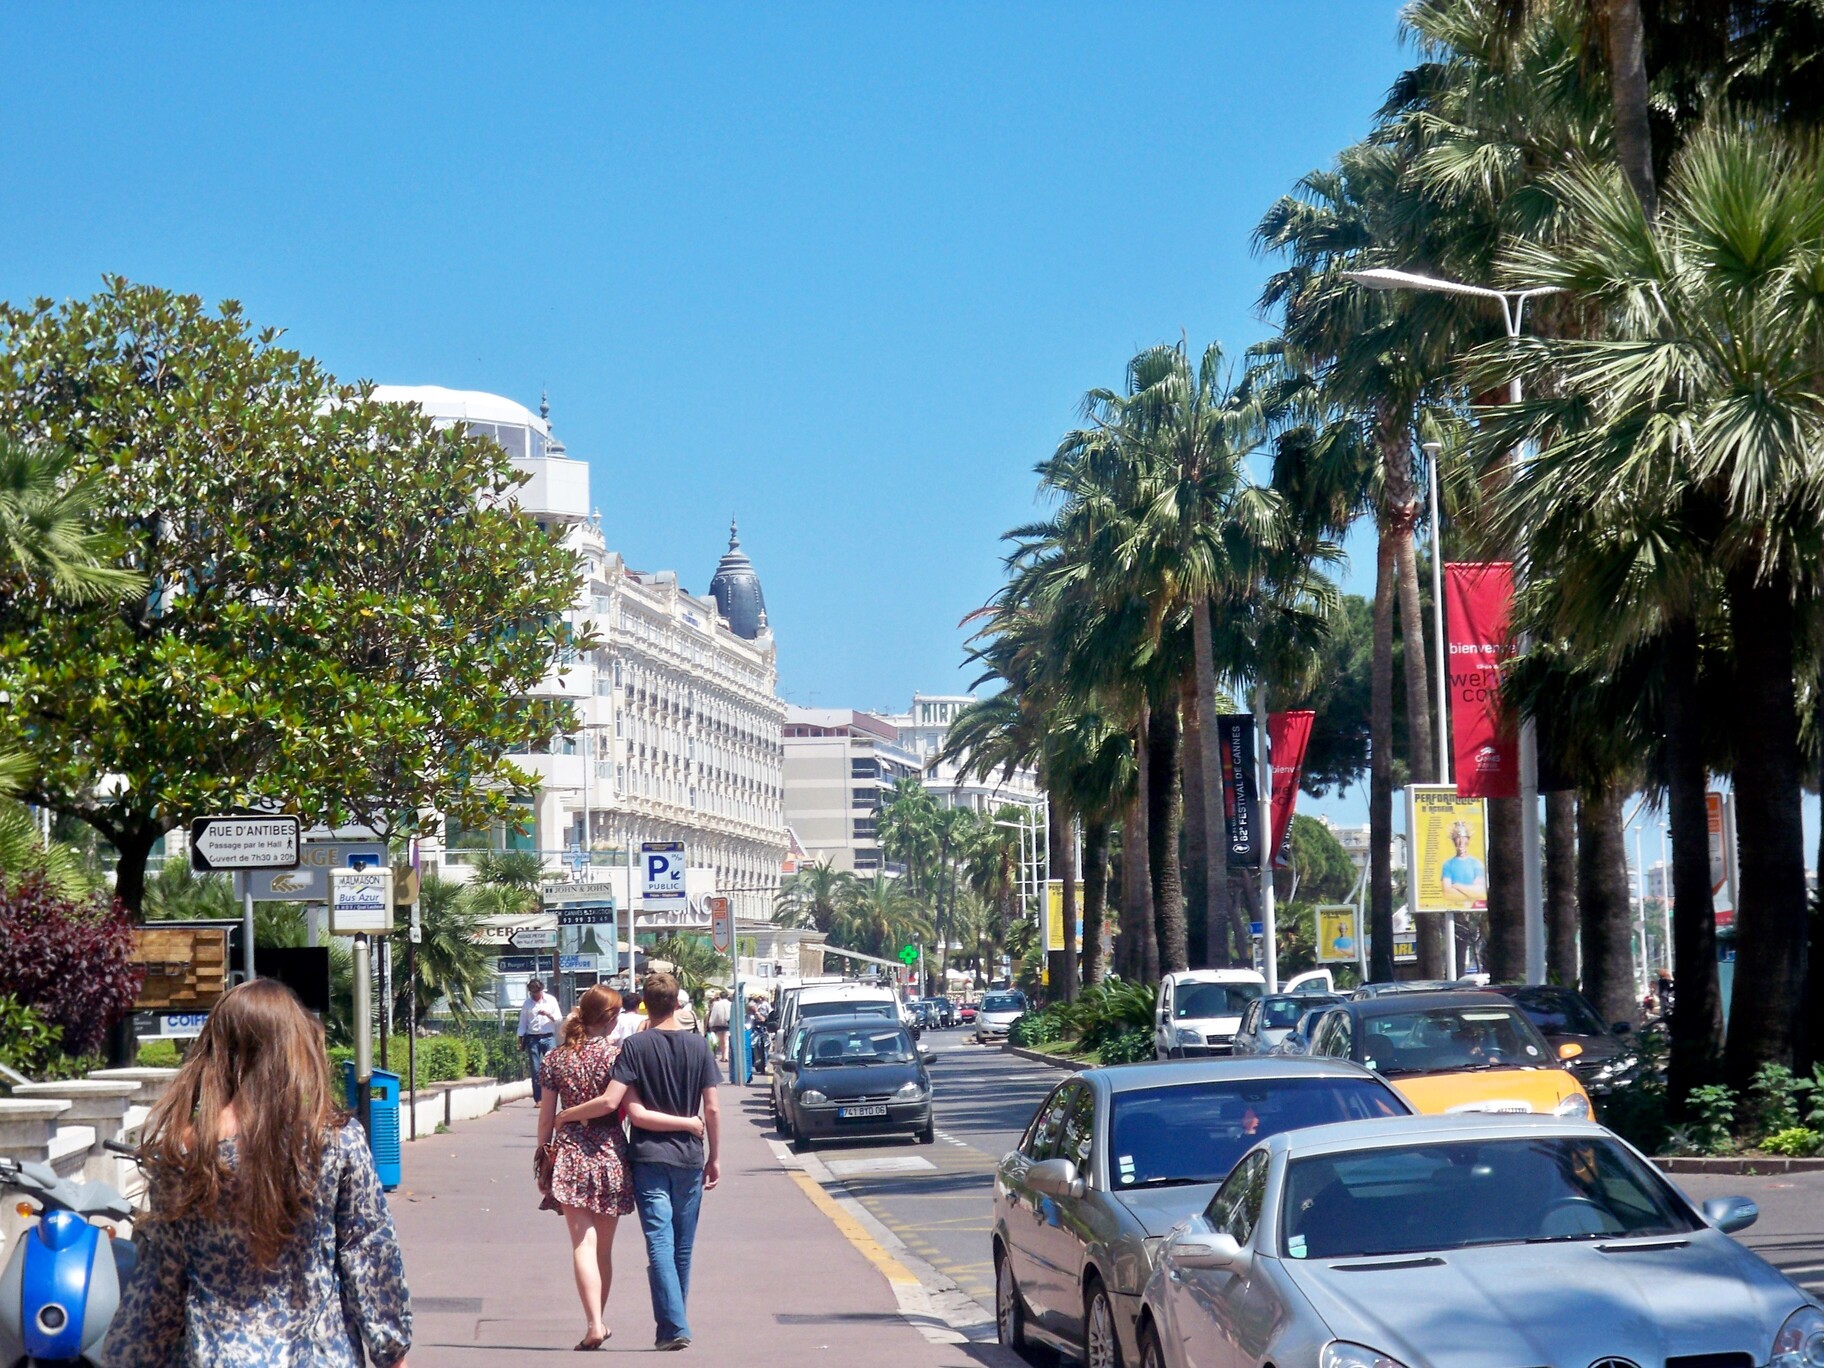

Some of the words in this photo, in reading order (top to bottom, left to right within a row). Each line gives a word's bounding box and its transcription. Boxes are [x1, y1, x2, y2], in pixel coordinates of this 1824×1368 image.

[1232, 725, 1241, 764] CANNES
[1234, 767, 1243, 779] DE
[1235, 780, 1247, 825] FESTIVAL
[209, 826, 232, 836] RUE
[236, 825, 295, 836] D'ANTIBES
[209, 842, 241, 850] Passage
[648, 855, 669, 881] P
[587, 884, 609, 892] JOHN
[844, 1108, 857, 1116] 741
